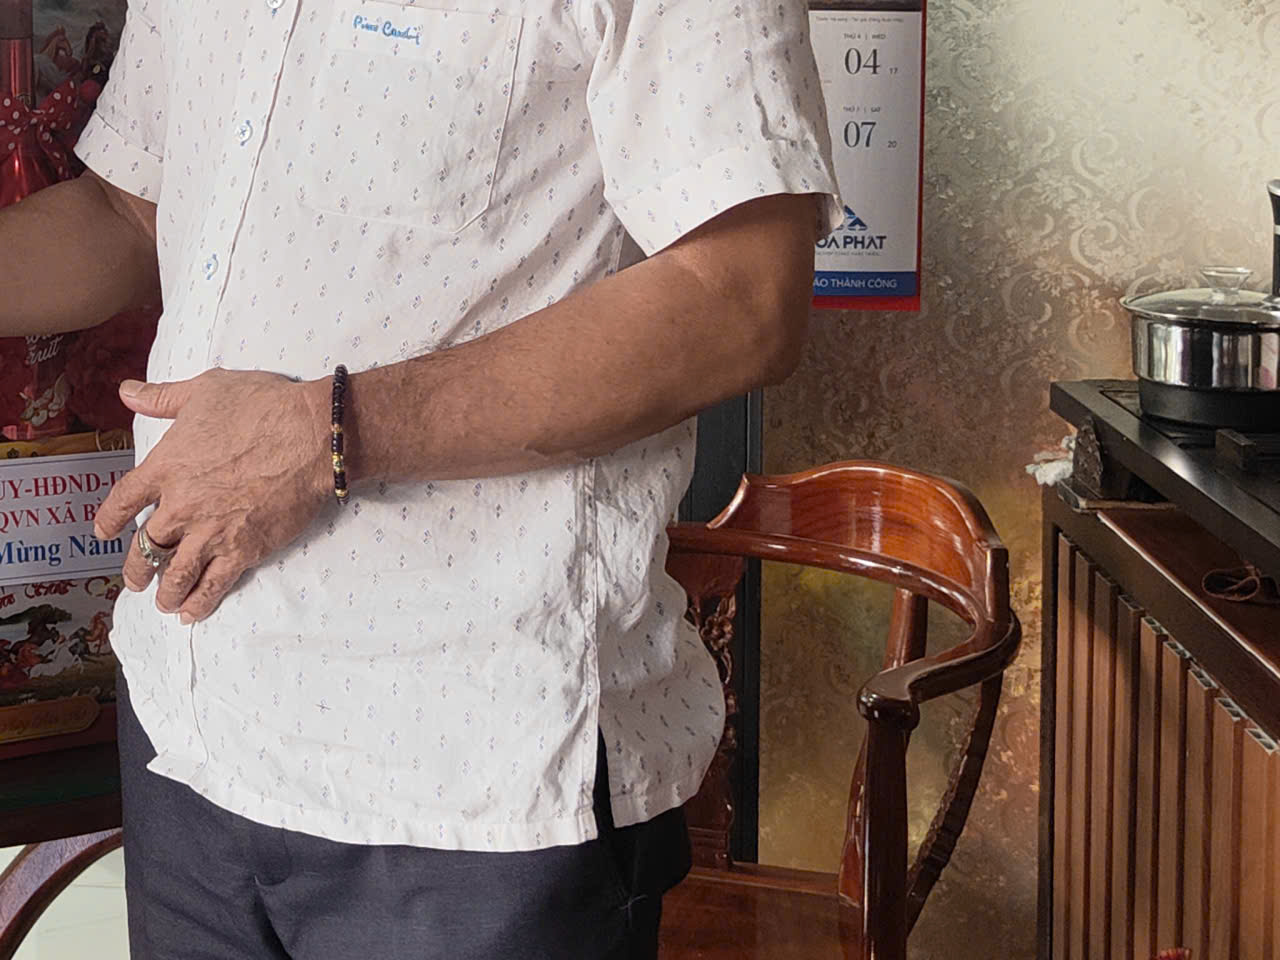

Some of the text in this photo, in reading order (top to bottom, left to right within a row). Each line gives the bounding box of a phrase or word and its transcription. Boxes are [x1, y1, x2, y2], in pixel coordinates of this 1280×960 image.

[844, 47, 881, 75] 04
[843, 120, 877, 148] 07
[830, 276, 866, 288] THÀNH
[867, 276, 898, 288] CÔNG
[46, 501, 77, 527] XÃ
